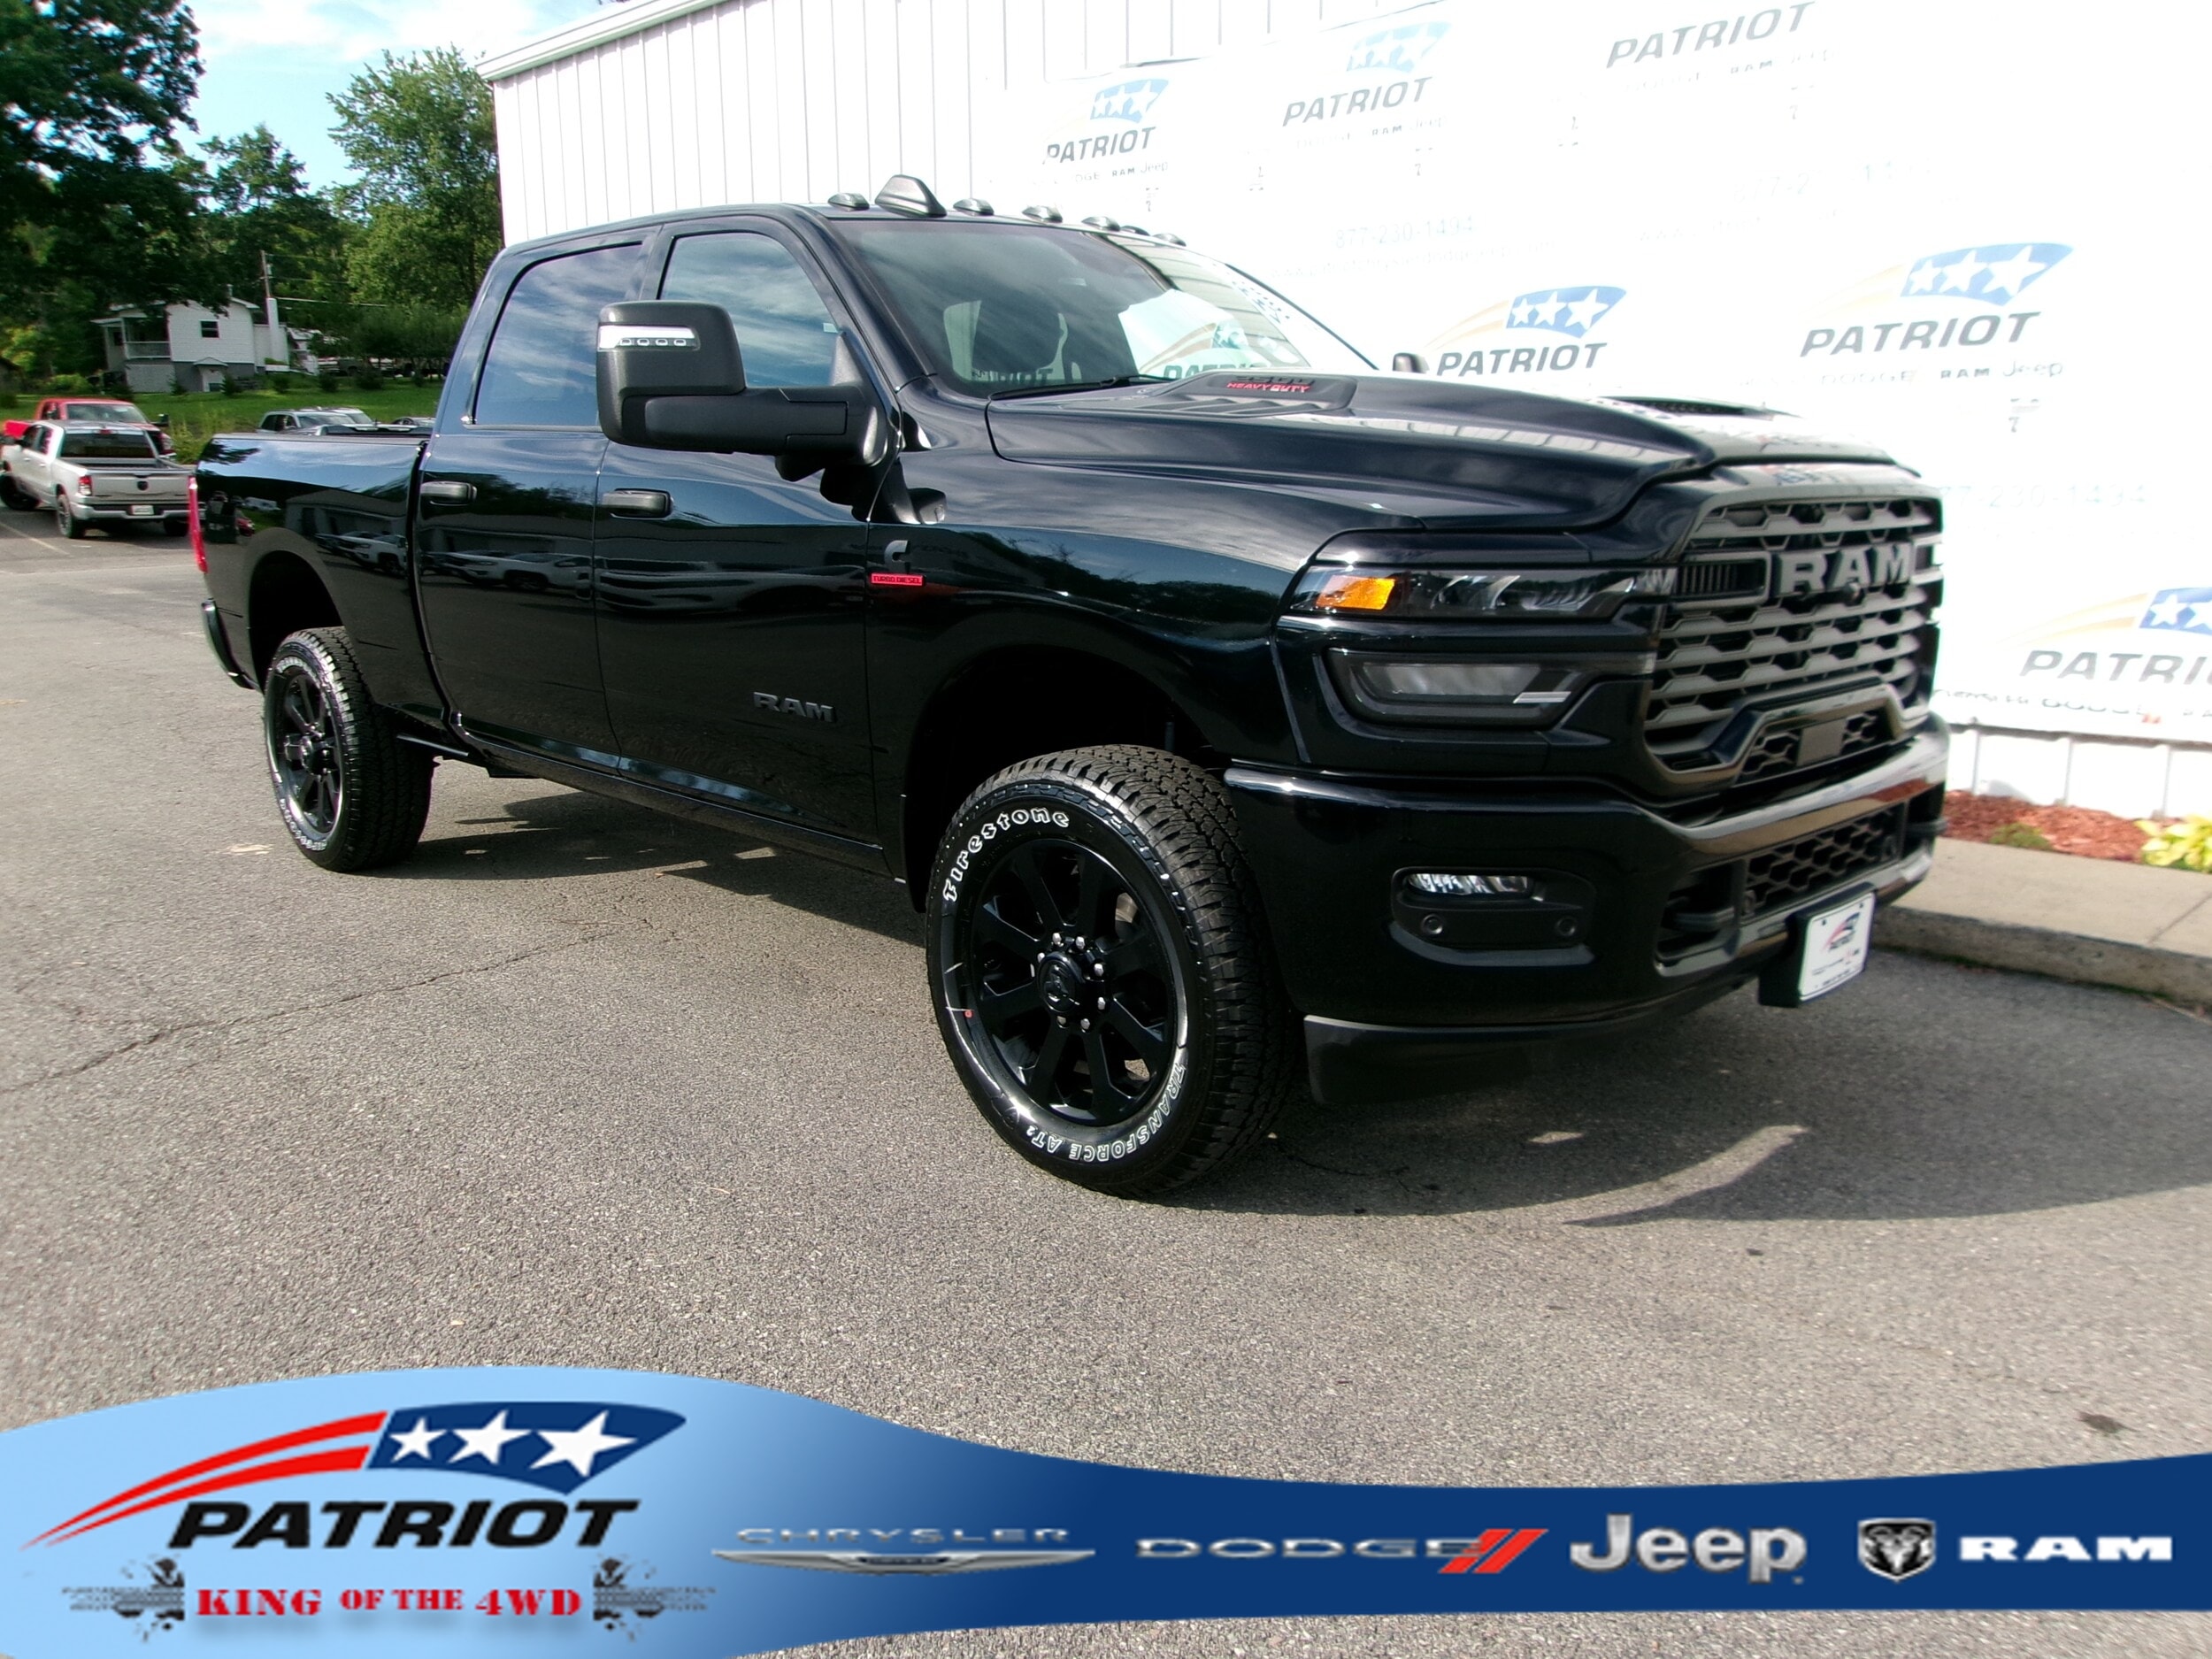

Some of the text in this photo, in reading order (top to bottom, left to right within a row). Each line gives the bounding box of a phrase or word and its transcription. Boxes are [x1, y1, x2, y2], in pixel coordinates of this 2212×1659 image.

[1606, 1, 1816, 70] PATRIOT
[1282, 76, 1433, 127] PATRIOT
[1042, 126, 1157, 165] PATRIOT
[1111, 166, 1136, 178] RAM
[1799, 311, 2042, 357] PATRIOT
[1436, 342, 1609, 377] PATRIOT
[1939, 366, 1992, 380] RAM
[2001, 360, 2064, 378] Jeep
[1225, 381, 1311, 393] HEAVY DUTY
[1777, 541, 1912, 595] RAM
[2019, 649, 2212, 685] PATRI
[753, 691, 835, 723] RAM
[941, 806, 1071, 902] Firestone
[1069, 1064, 1187, 1163] TRANSFORCE
